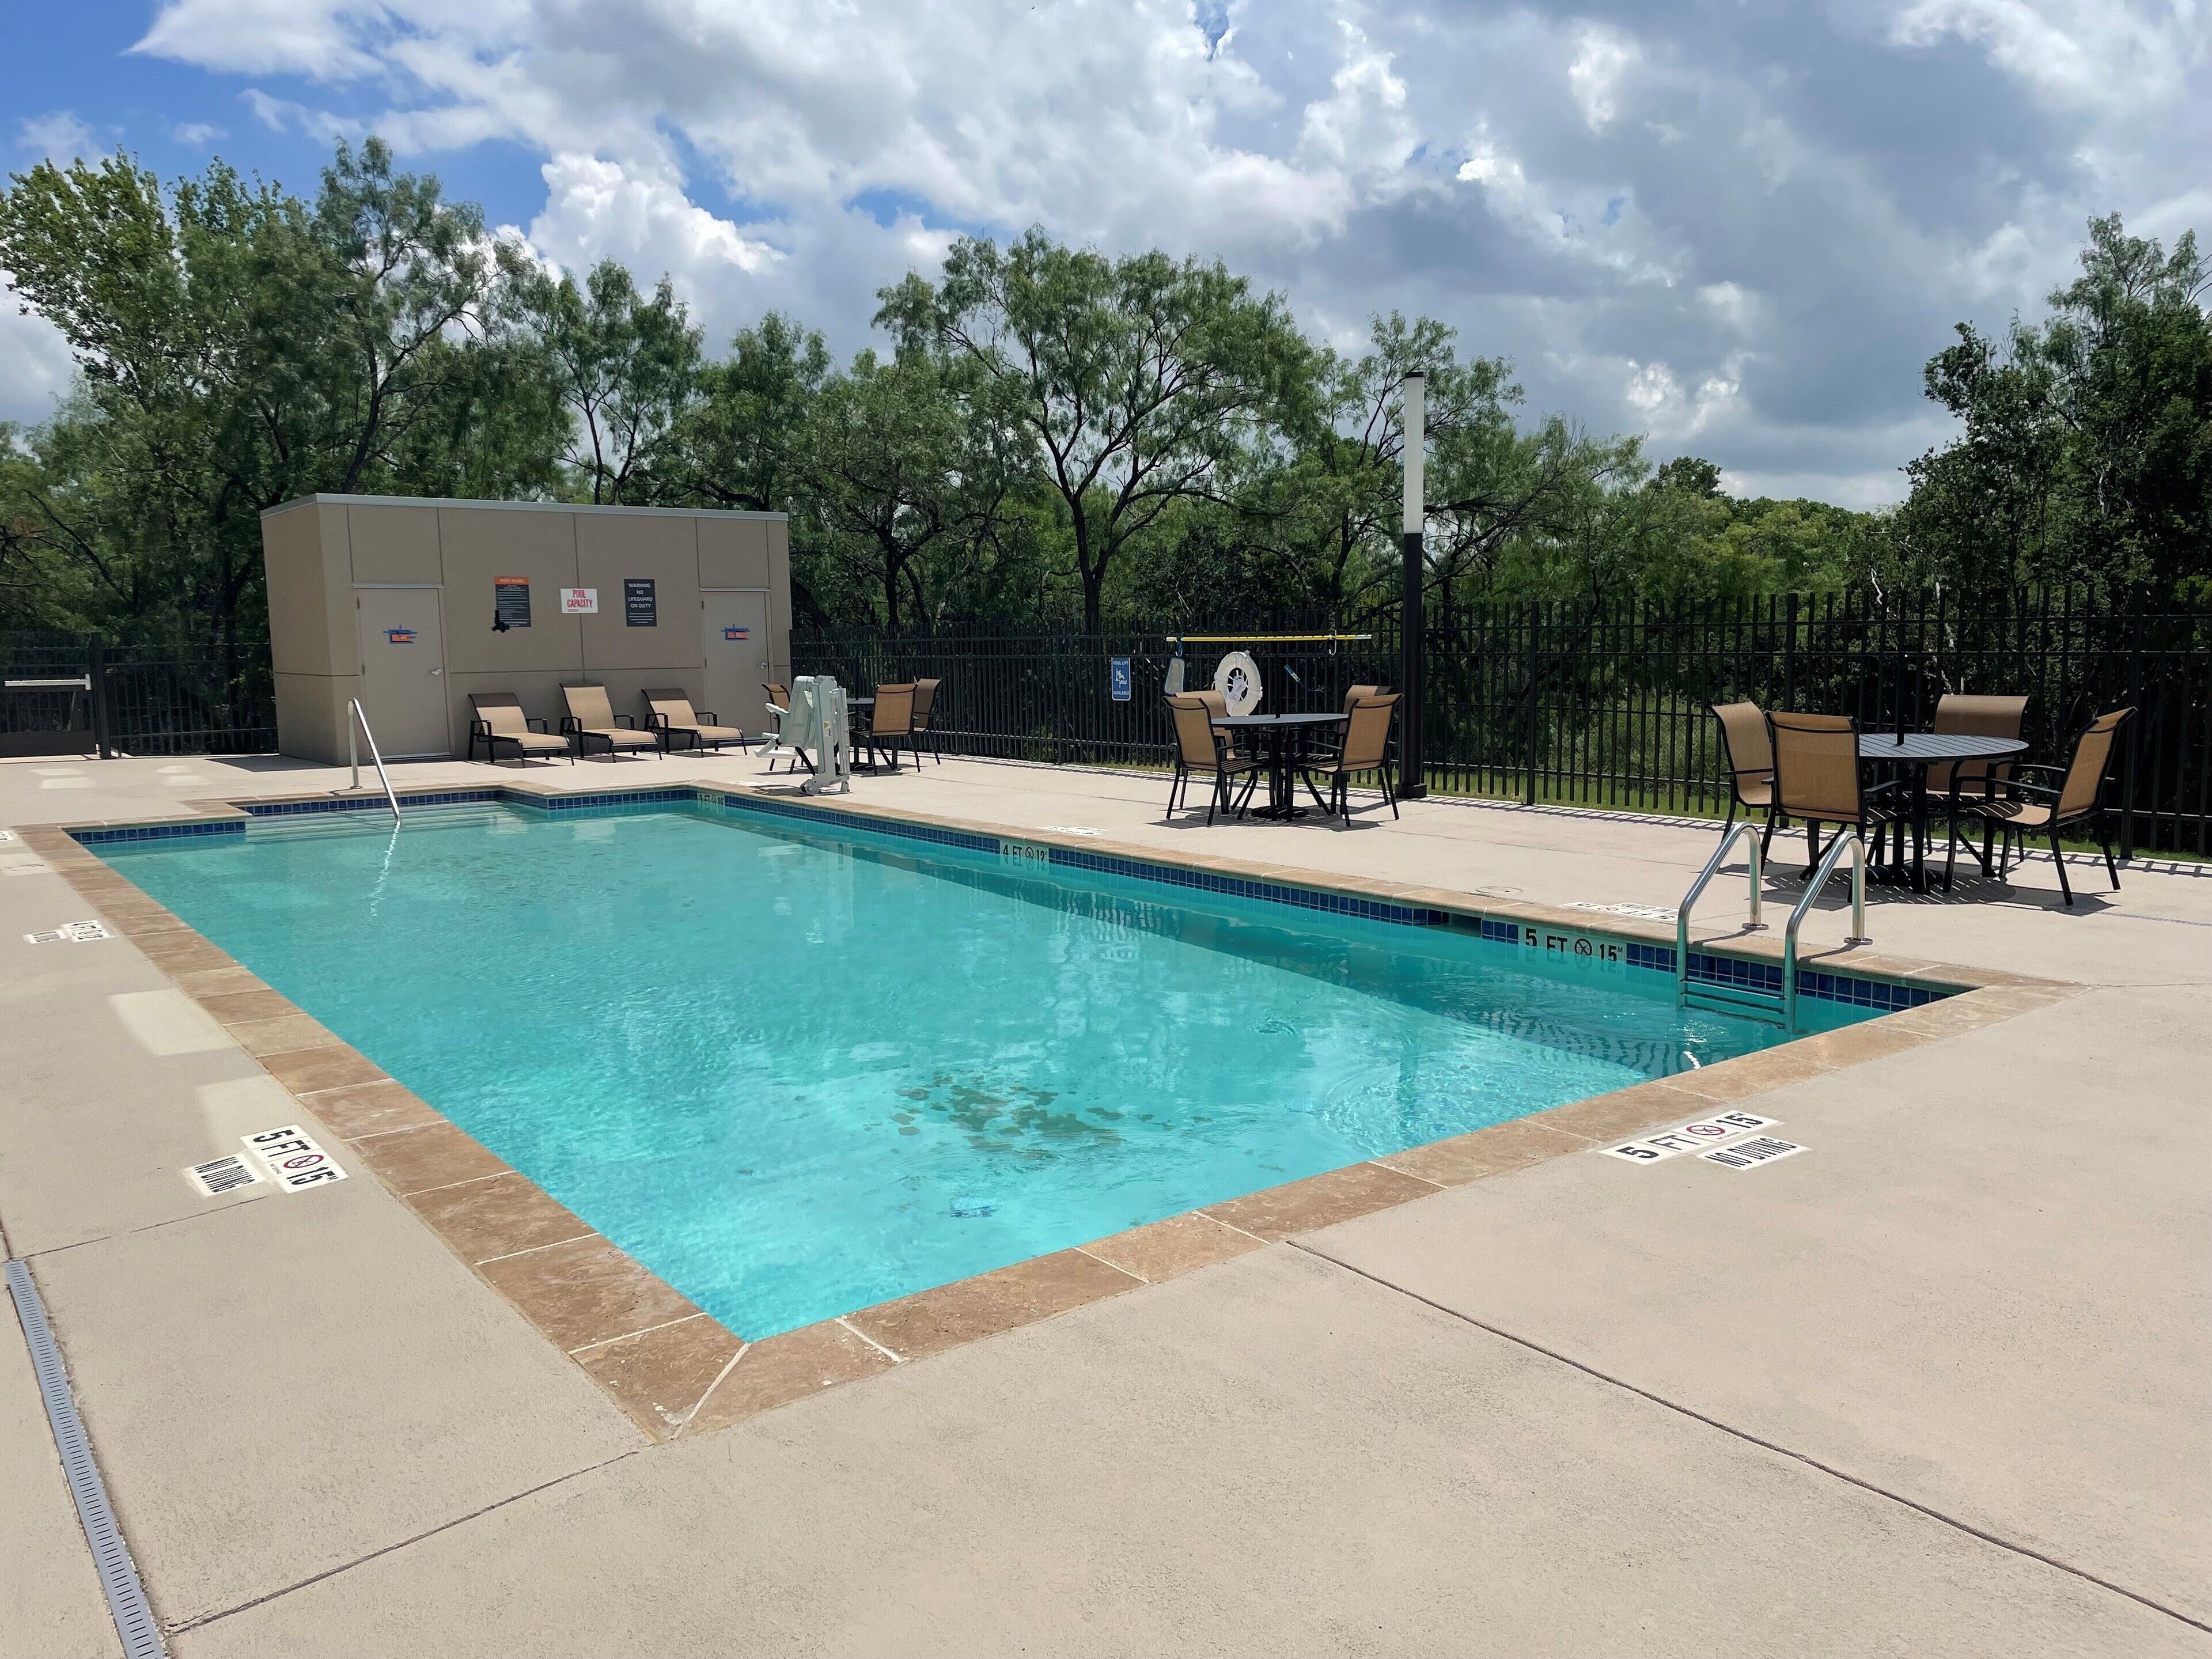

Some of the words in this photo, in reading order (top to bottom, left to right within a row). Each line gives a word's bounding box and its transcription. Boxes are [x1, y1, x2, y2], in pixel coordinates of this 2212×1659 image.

[573, 590, 586, 598] POOL
[567, 599, 592, 608] CAPACITY
[1003, 844, 1009, 855] 4
[1013, 846, 1022, 858] FT
[1525, 928, 1537, 946] 5
[1547, 935, 1567, 953] FT
[253, 1130, 295, 1142] 5
[261, 1140, 310, 1157] FT
[1615, 1146, 1659, 1158] 5
[1647, 1135, 1701, 1150] FT
[1726, 1138, 1797, 1160] DIVING
[194, 1157, 239, 1173] NO
[1704, 1153, 1752, 1167] NO
[200, 1165, 255, 1192] DIVING
